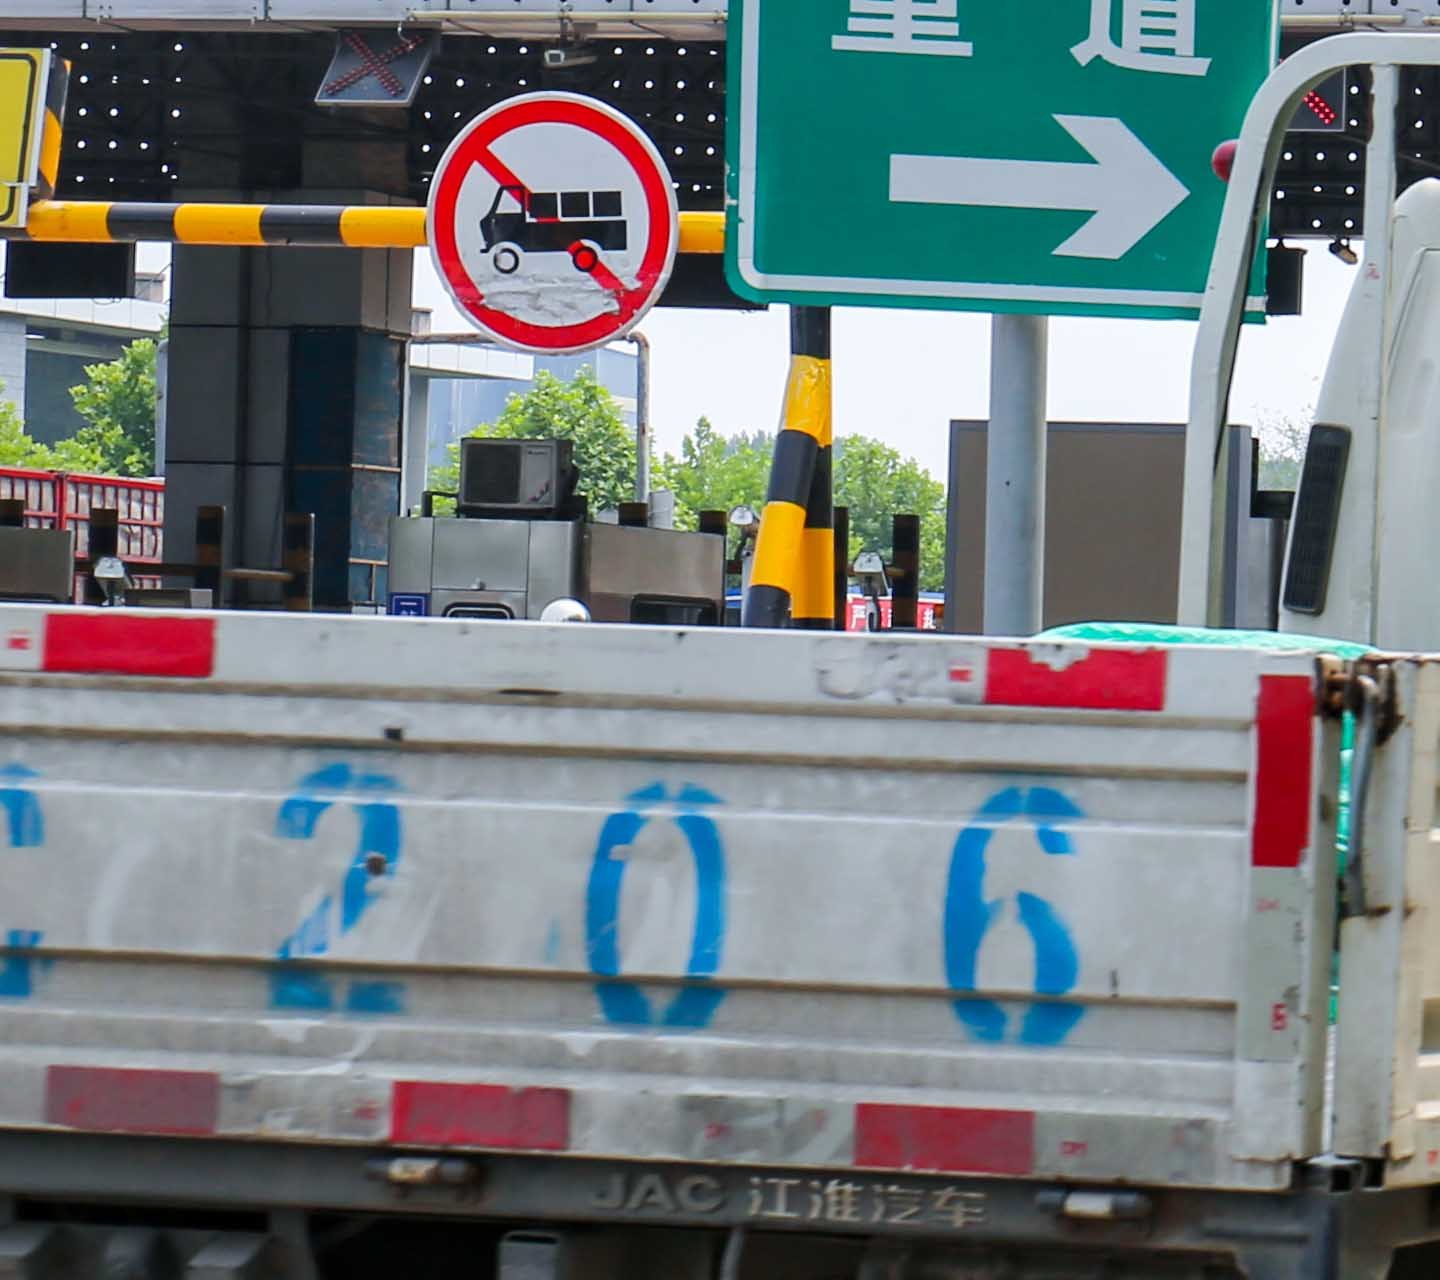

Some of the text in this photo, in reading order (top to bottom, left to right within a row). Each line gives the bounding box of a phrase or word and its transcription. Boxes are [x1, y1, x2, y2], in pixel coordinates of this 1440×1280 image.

[592, 1172, 988, 1228] JAC 江淮汽车
